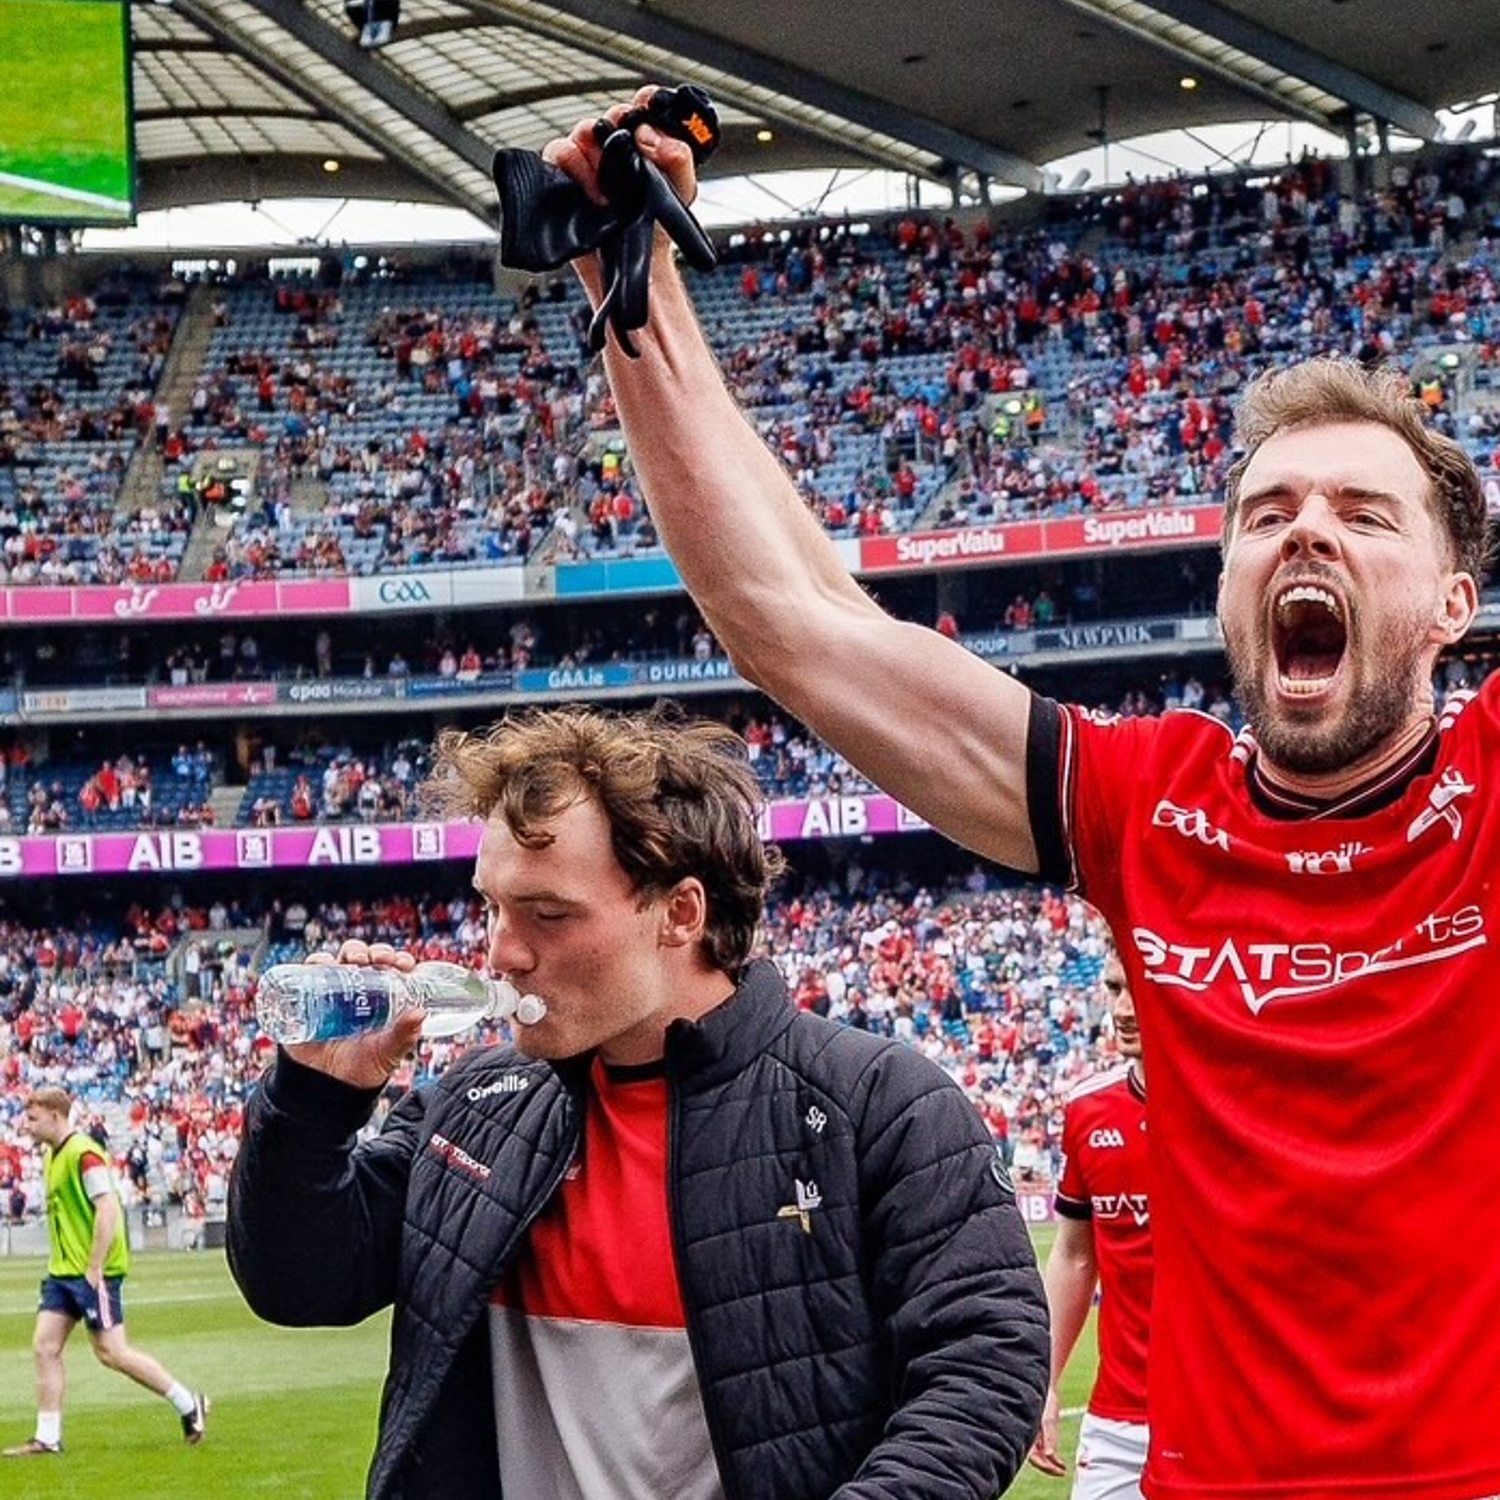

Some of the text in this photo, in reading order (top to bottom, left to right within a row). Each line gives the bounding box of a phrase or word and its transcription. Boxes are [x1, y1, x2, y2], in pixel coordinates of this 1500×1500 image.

[1084, 511, 1195, 545] SuperValu
[897, 529, 1004, 562] SuperValu
[379, 580, 430, 603] GAA
[1058, 623, 1151, 648] NEWPARK
[549, 667, 604, 688] GAA.ie
[650, 661, 728, 681] DURKAN
[802, 800, 868, 836] AIB
[129, 833, 203, 871] AIB
[308, 827, 382, 864] AIB
[1089, 1129, 1124, 1148] GAA
